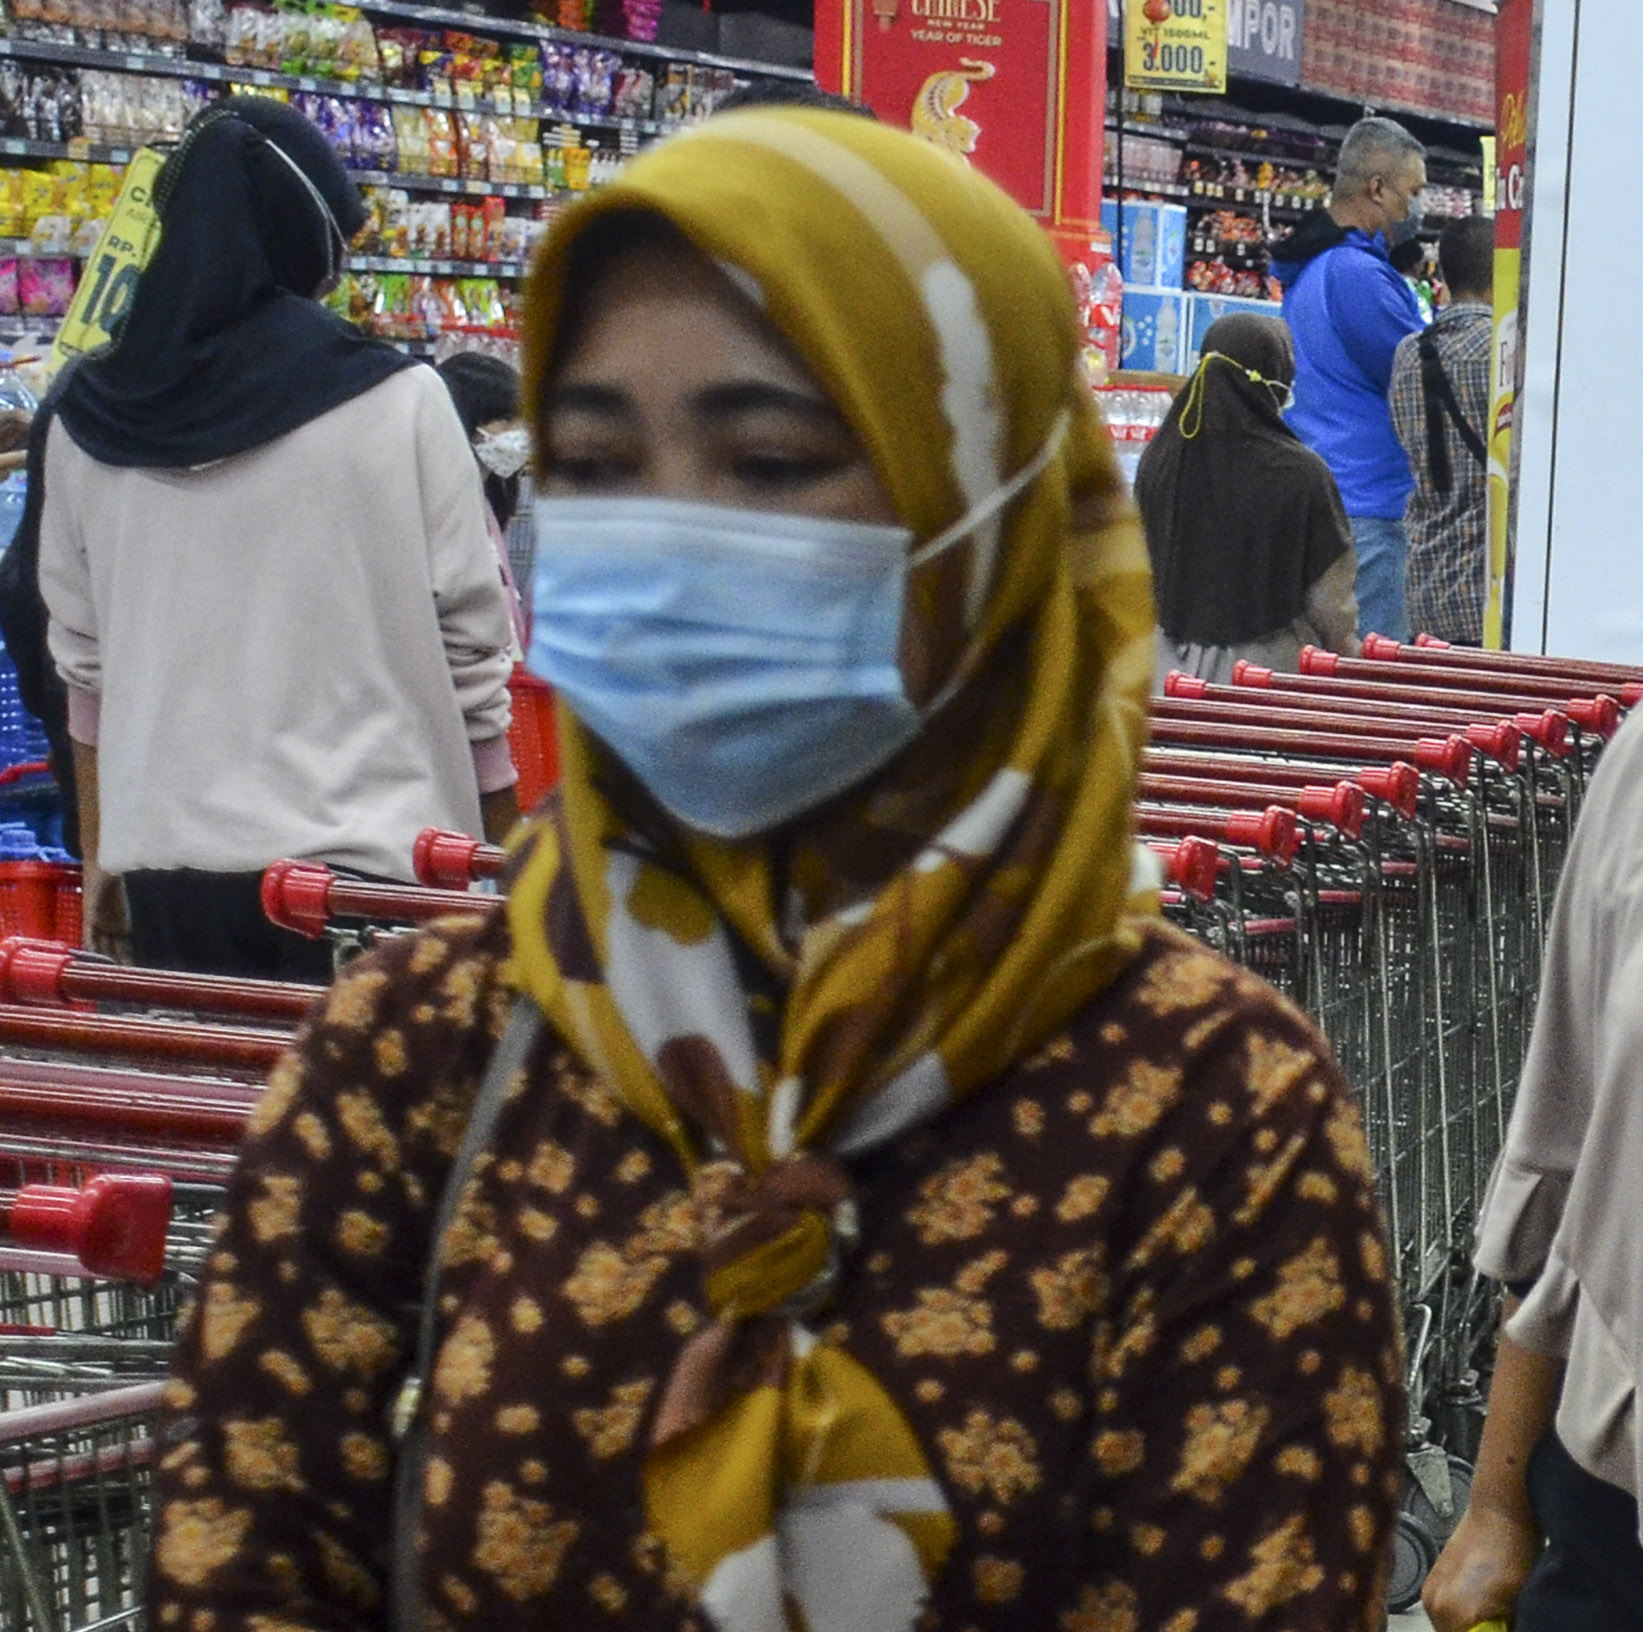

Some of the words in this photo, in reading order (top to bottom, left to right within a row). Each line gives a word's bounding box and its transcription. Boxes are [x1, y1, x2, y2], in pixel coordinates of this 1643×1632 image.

[911, 28, 944, 42] YEAR
[945, 32, 963, 44] OF
[965, 33, 1003, 47] TIGER
[1228, 0, 1296, 60] MPOR
